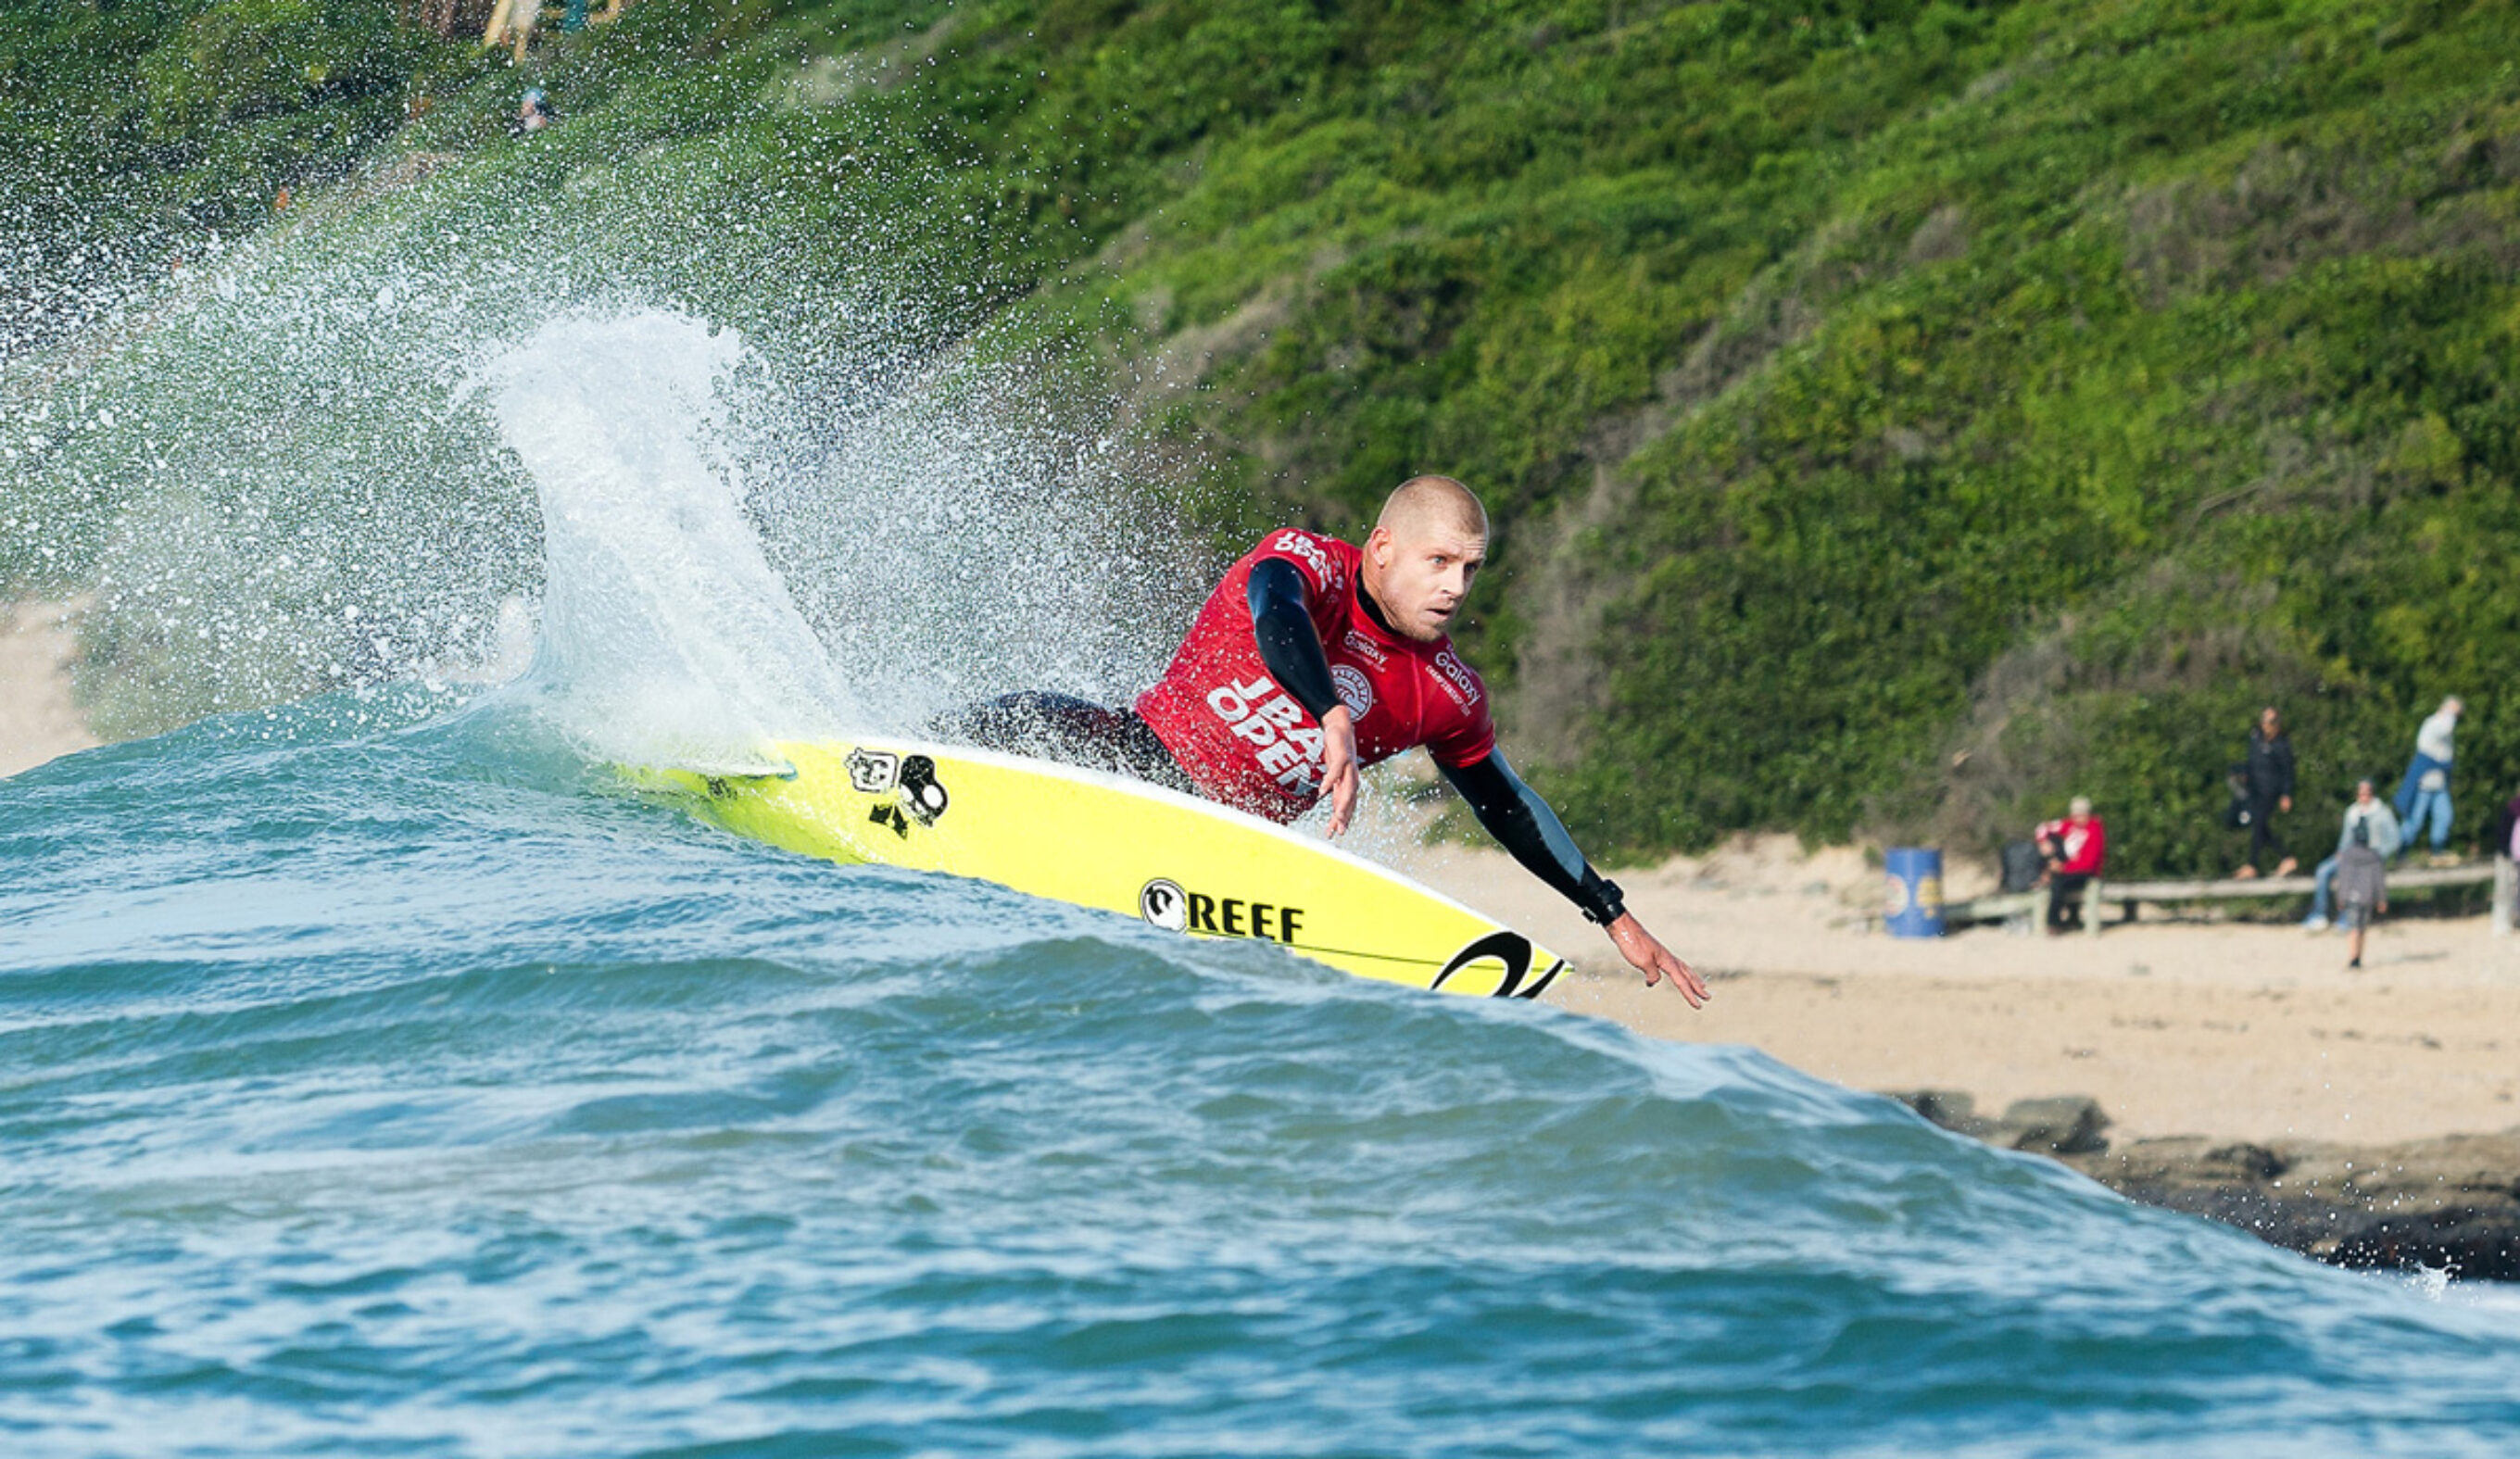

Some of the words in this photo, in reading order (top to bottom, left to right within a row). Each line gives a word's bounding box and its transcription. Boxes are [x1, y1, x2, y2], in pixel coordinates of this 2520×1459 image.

[1435, 652, 1481, 706] Galaxy
[1230, 675, 1331, 774] JBA
[1188, 892, 1304, 944] REEF
